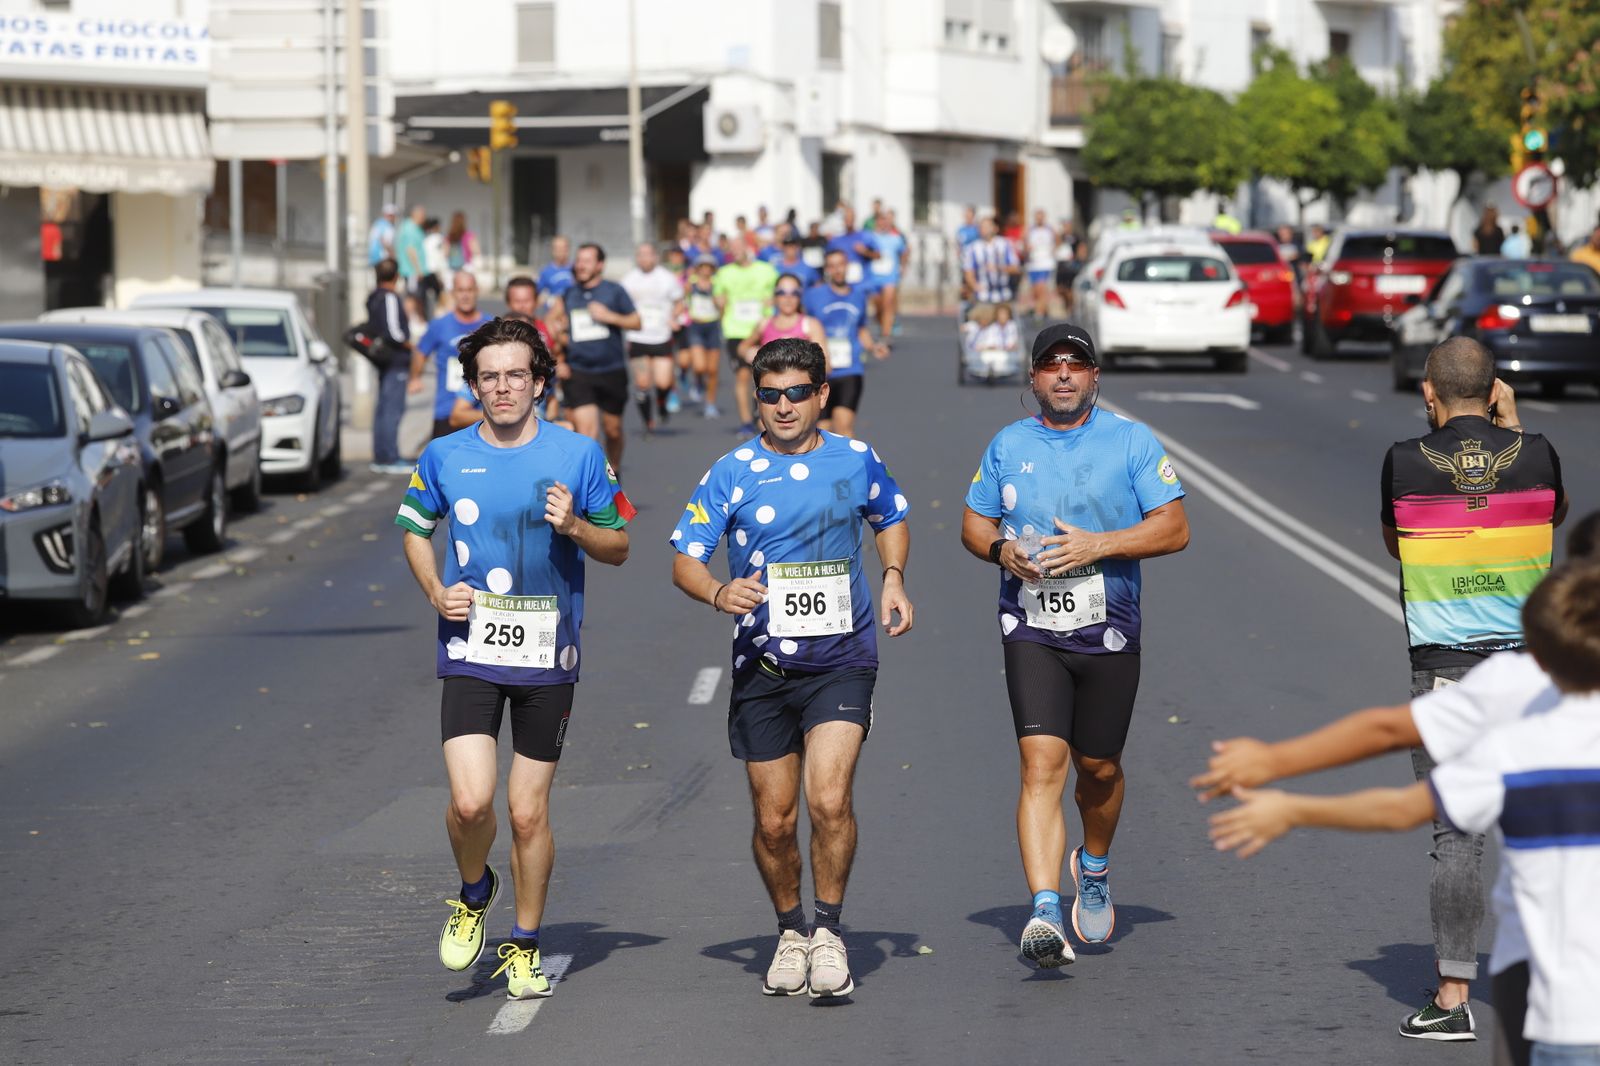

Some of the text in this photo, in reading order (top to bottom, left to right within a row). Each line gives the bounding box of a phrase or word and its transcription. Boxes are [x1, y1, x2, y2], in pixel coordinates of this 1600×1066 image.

[0, 40, 198, 62] ATAS FRITAS
[1461, 455, 1488, 468] B&T
[784, 565, 813, 578] VUELTA
[814, 566, 820, 576] A
[822, 563, 845, 575] HUELVA
[1069, 565, 1097, 577] HUELVA
[1451, 574, 1506, 588] IBHOLA
[1474, 585, 1506, 593] RUNNING
[488, 598, 515, 610] VUELTA
[516, 600, 522, 610] A
[524, 600, 551, 611] HUELVA
[785, 591, 826, 617] 596
[1036, 591, 1076, 613] 156
[483, 622, 525, 648] 259
